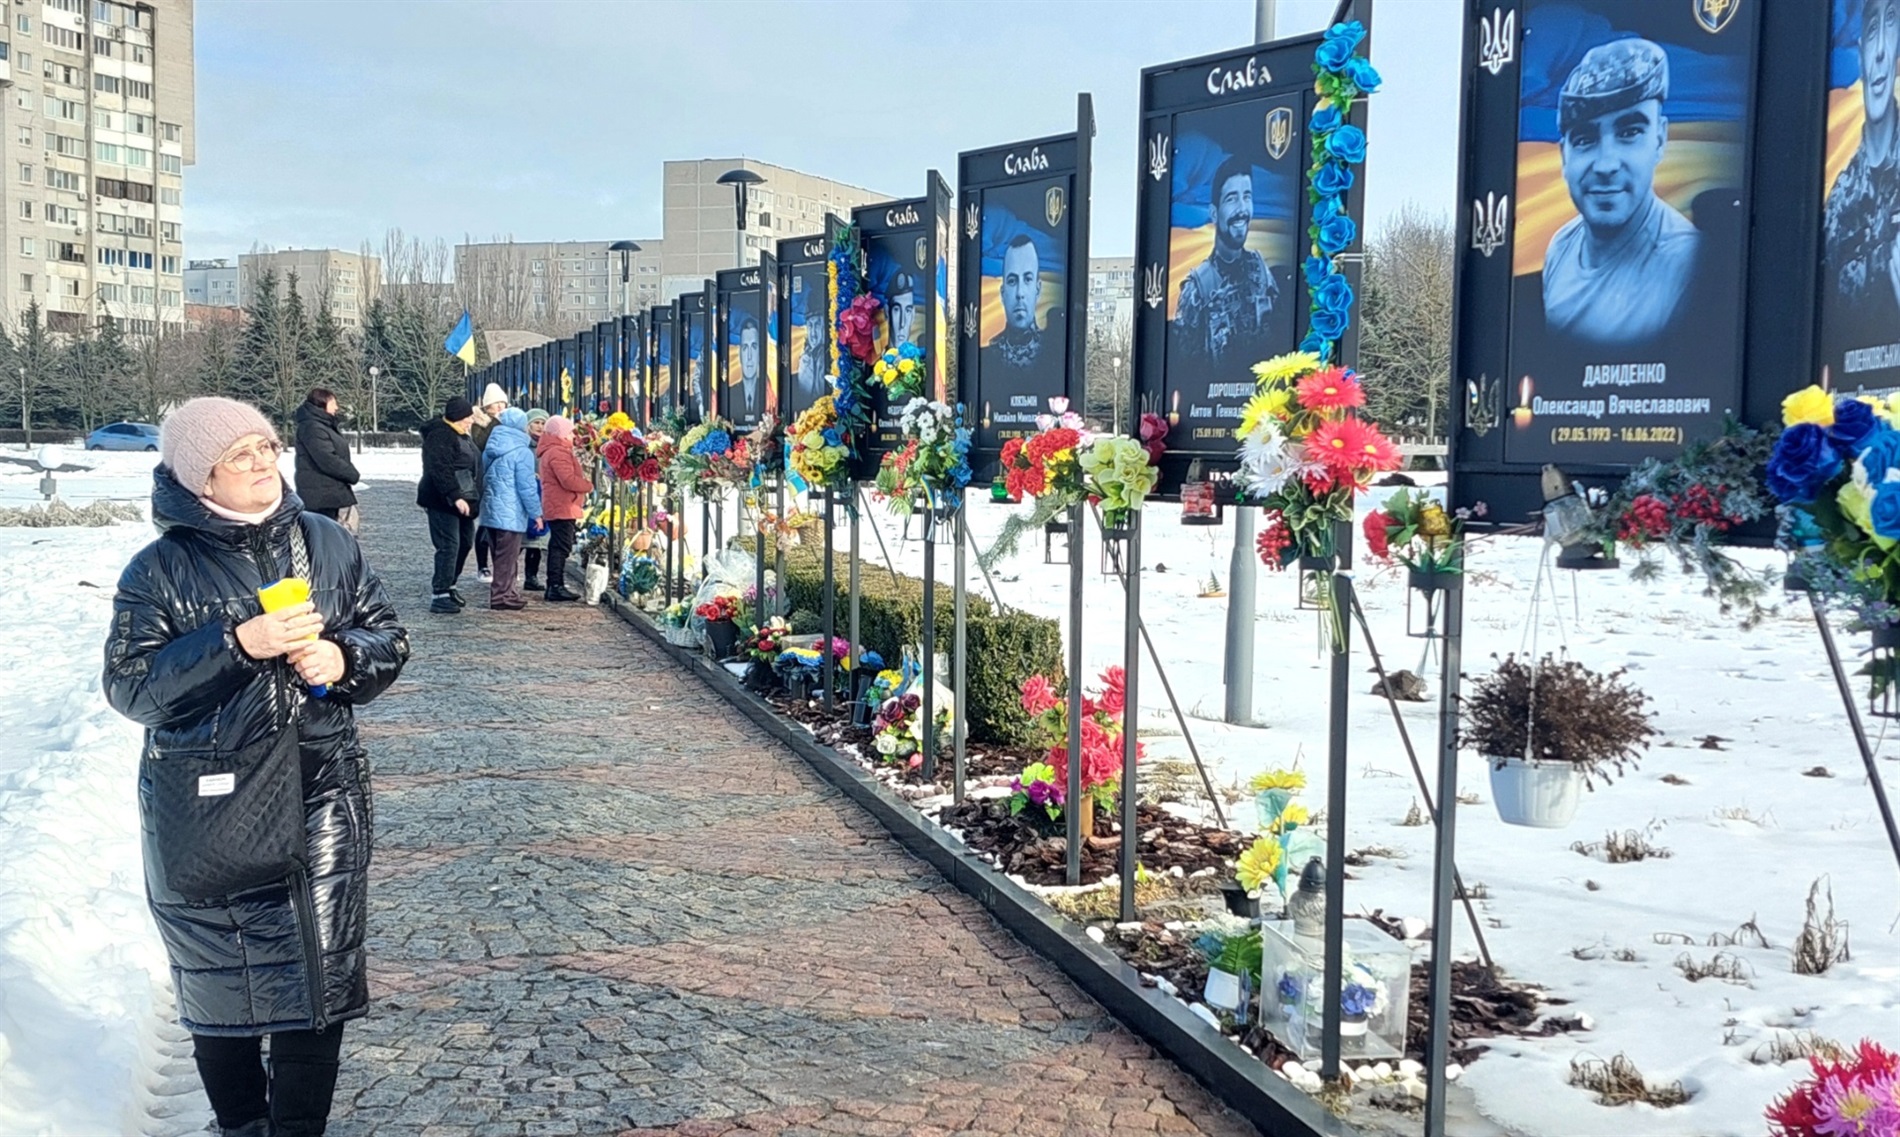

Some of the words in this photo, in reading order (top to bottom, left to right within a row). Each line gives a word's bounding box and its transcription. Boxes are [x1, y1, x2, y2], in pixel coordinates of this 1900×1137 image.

[1206, 56, 1273, 95] Слава
[1004, 146, 1049, 175] Слава
[885, 204, 919, 228] Слава
[803, 238, 825, 257] Слав
[1582, 363, 1666, 387] ДАВИДЕНКО
[1207, 382, 1256, 399] ДОРОЩЕНКО
[1189, 403, 1213, 418] Антон
[1532, 395, 1605, 419] Олександр
[1608, 394, 1710, 415] Вячеславович
